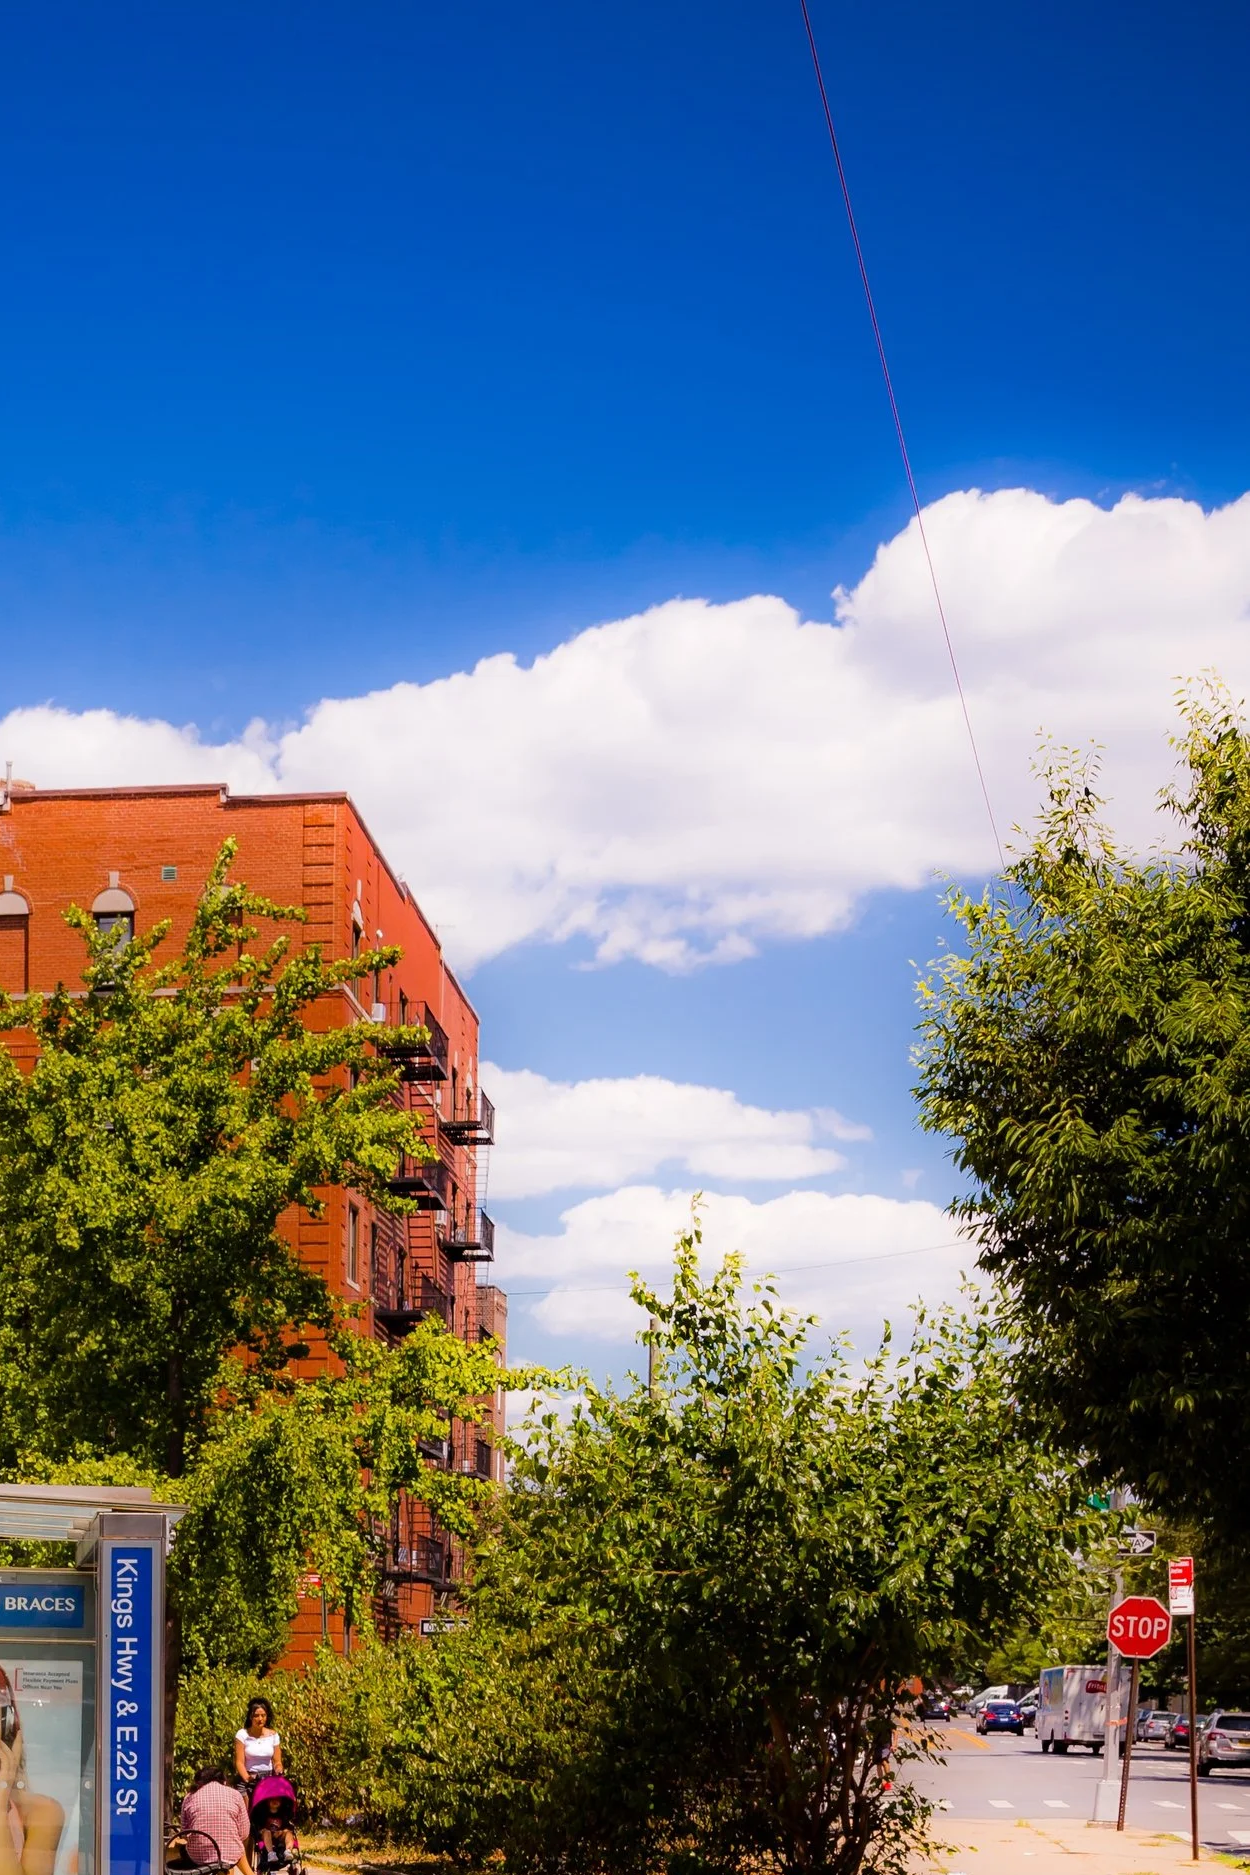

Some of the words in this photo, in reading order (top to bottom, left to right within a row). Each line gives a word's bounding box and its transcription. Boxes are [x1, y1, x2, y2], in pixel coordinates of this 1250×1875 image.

[4, 1596, 76, 1612] BRACES
[111, 1558, 139, 1629] Kings
[1111, 1615, 1168, 1640] STOP
[111, 1637, 139, 1692] Hwy
[116, 1699, 139, 1718] &
[116, 1788, 139, 1816] St
